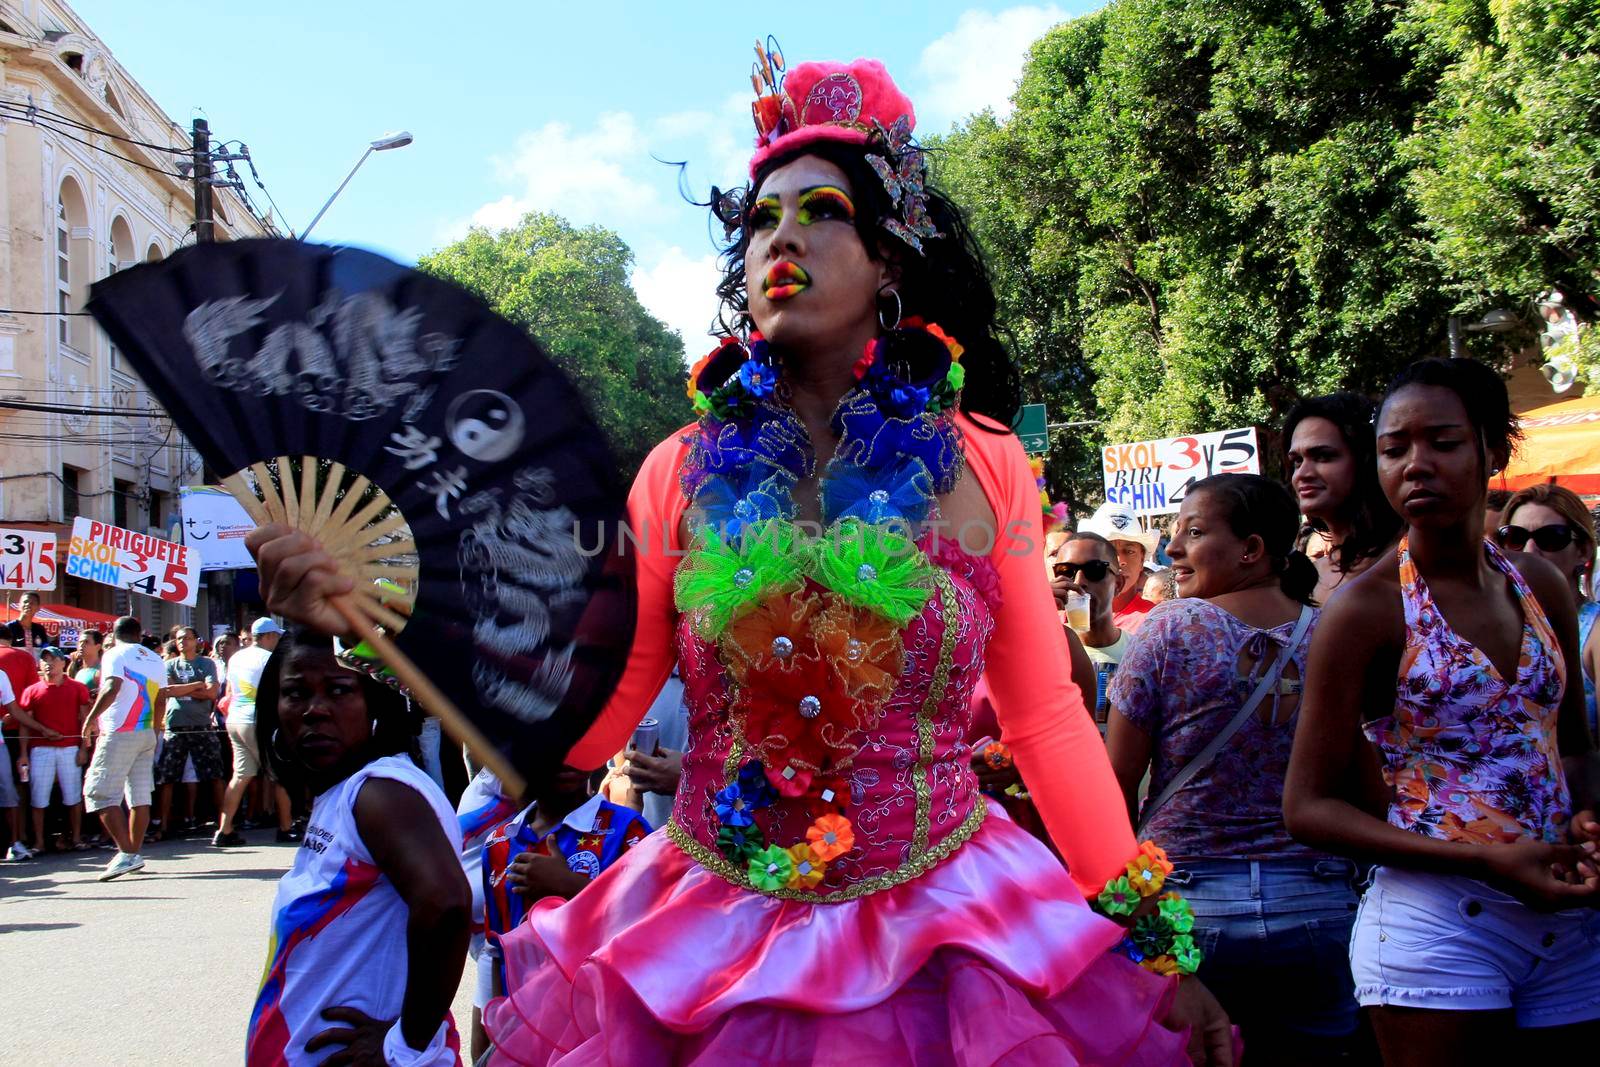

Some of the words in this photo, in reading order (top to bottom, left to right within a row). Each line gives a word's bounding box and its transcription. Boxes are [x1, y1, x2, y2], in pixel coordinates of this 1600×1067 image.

[1104, 443, 1163, 473] SKOL
[1168, 437, 1202, 470] 3
[1218, 429, 1255, 466] 5
[1107, 482, 1166, 510] SCHIN
[5, 534, 25, 554] 3
[39, 543, 56, 584] 5
[70, 536, 120, 566] SKOL
[121, 551, 148, 572] 3
[89, 521, 187, 567] PIRIGUETE
[6, 562, 25, 588] 4
[67, 555, 120, 585] SCHIN
[131, 575, 157, 594] 4
[160, 563, 189, 602] 5
